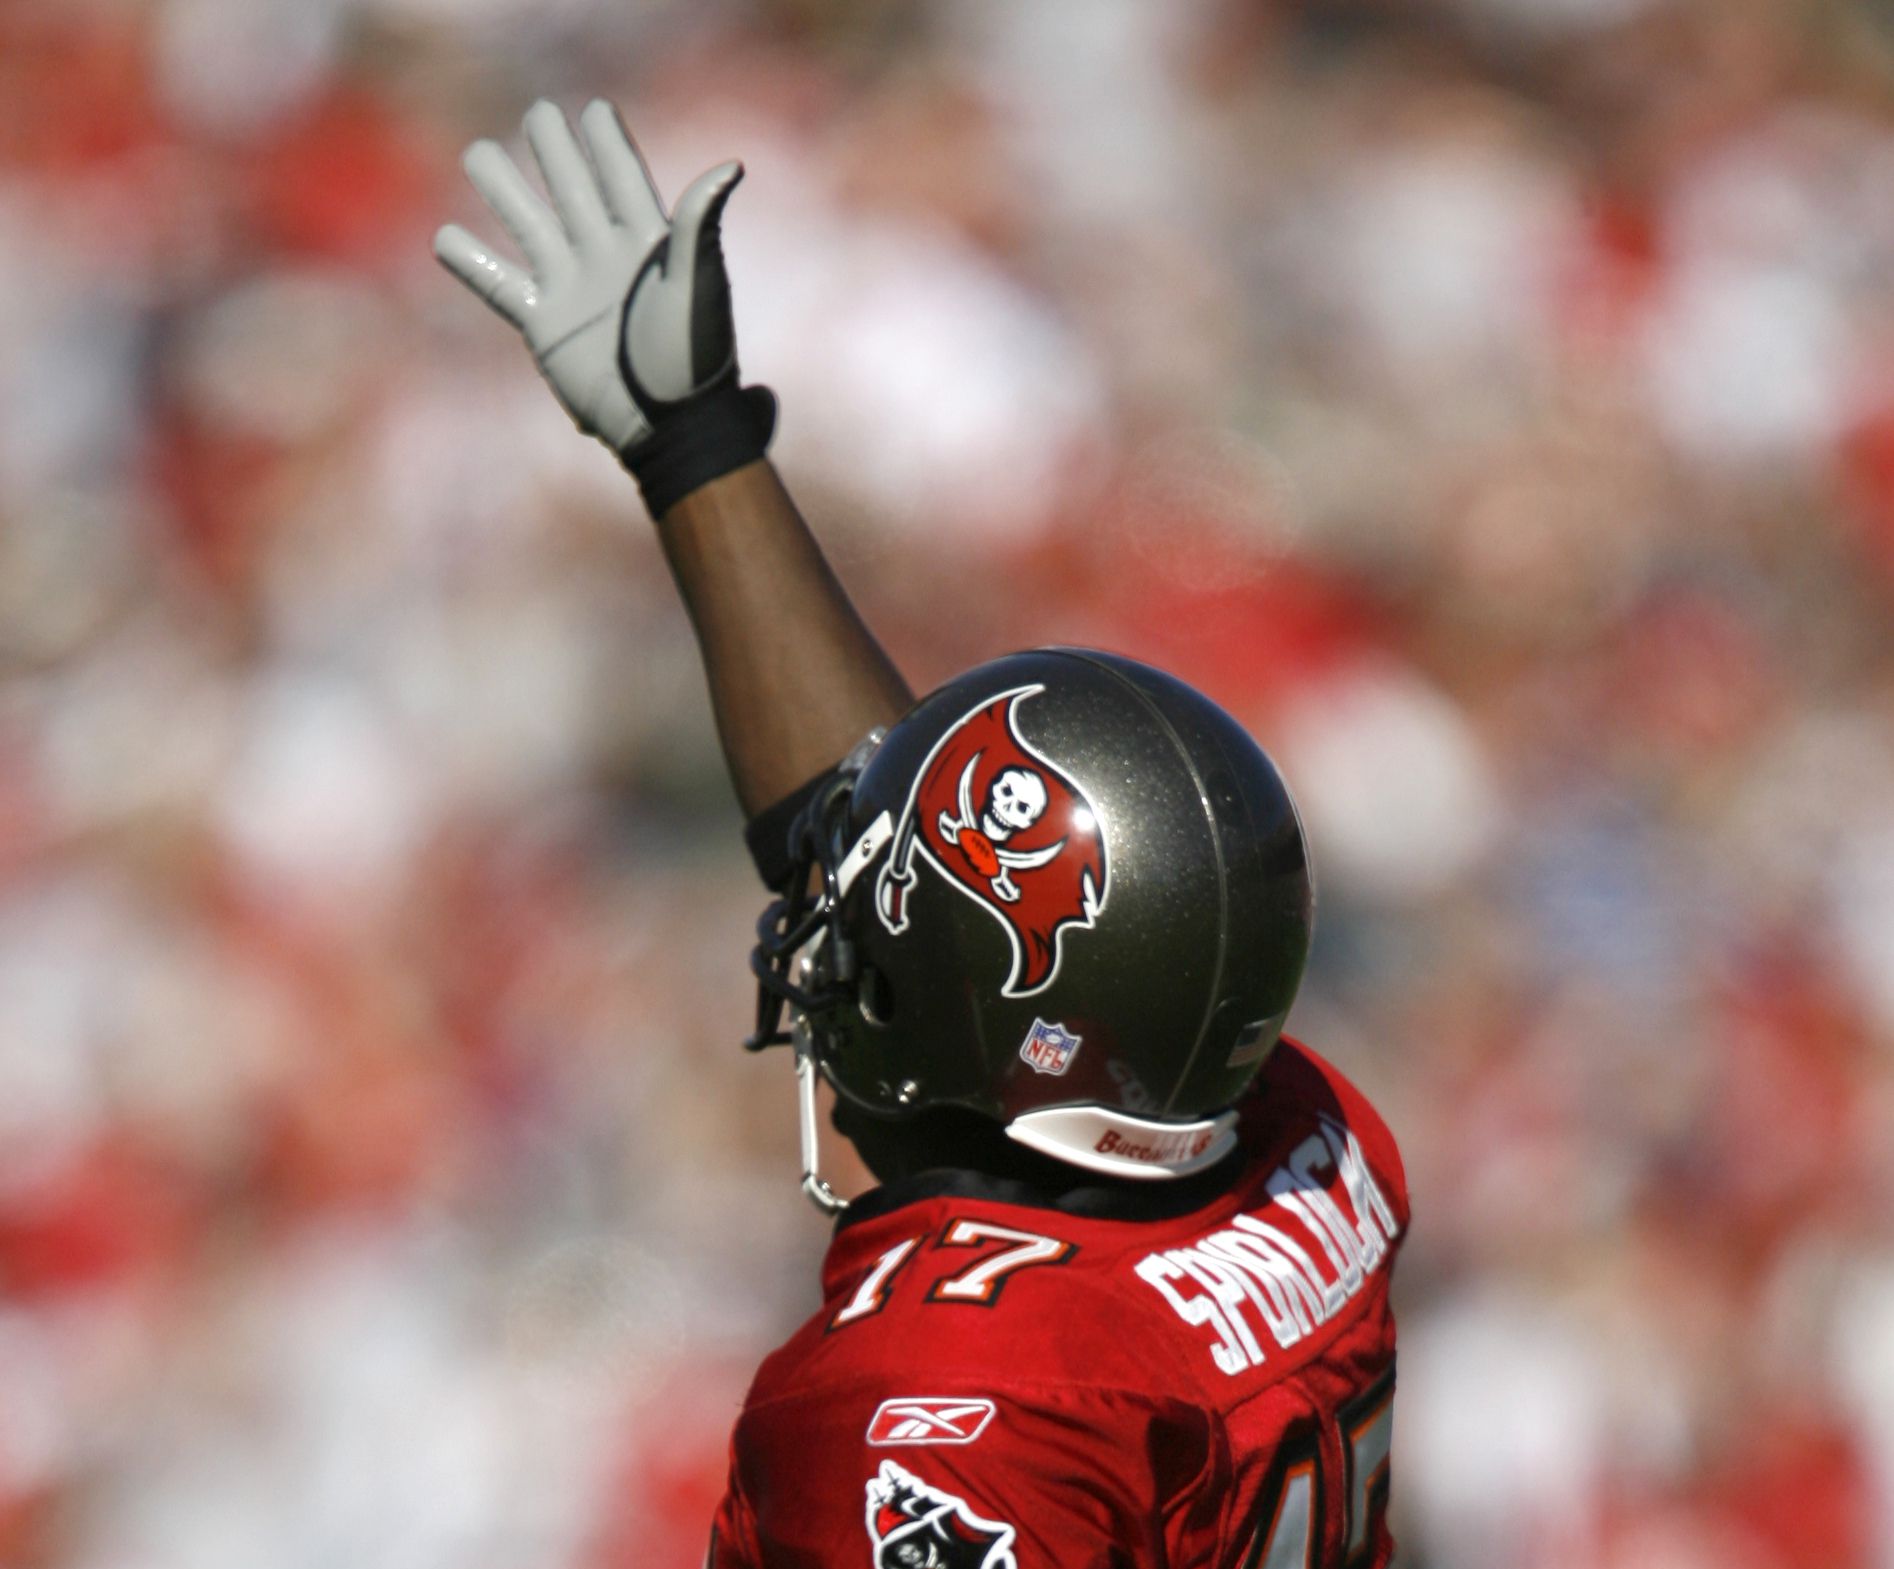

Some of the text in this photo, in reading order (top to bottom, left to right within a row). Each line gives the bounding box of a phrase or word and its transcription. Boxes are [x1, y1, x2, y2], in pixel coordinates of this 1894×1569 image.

[1025, 1037, 1066, 1069] NFL
[825, 1217, 1077, 1334] 17
[1134, 1112, 1397, 1375] SPURLOCK
